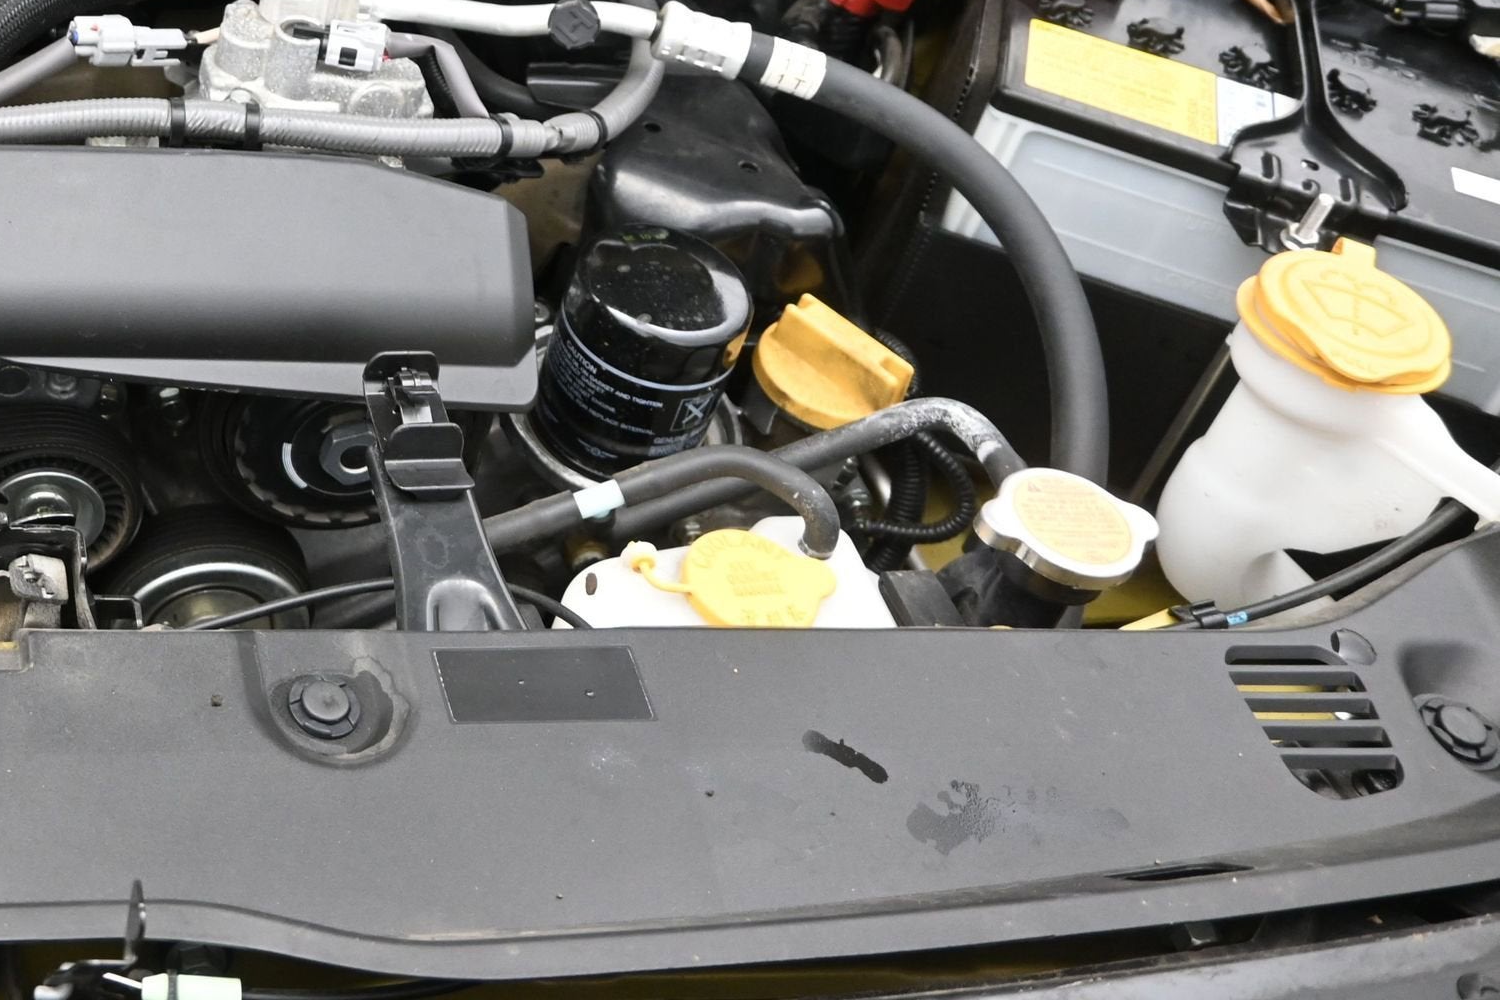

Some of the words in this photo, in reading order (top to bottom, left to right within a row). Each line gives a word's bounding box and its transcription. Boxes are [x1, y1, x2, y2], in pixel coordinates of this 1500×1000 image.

[566, 339, 598, 375] CAUTION
[614, 390, 631, 401] AND
[691, 533, 794, 569] COOLANT
